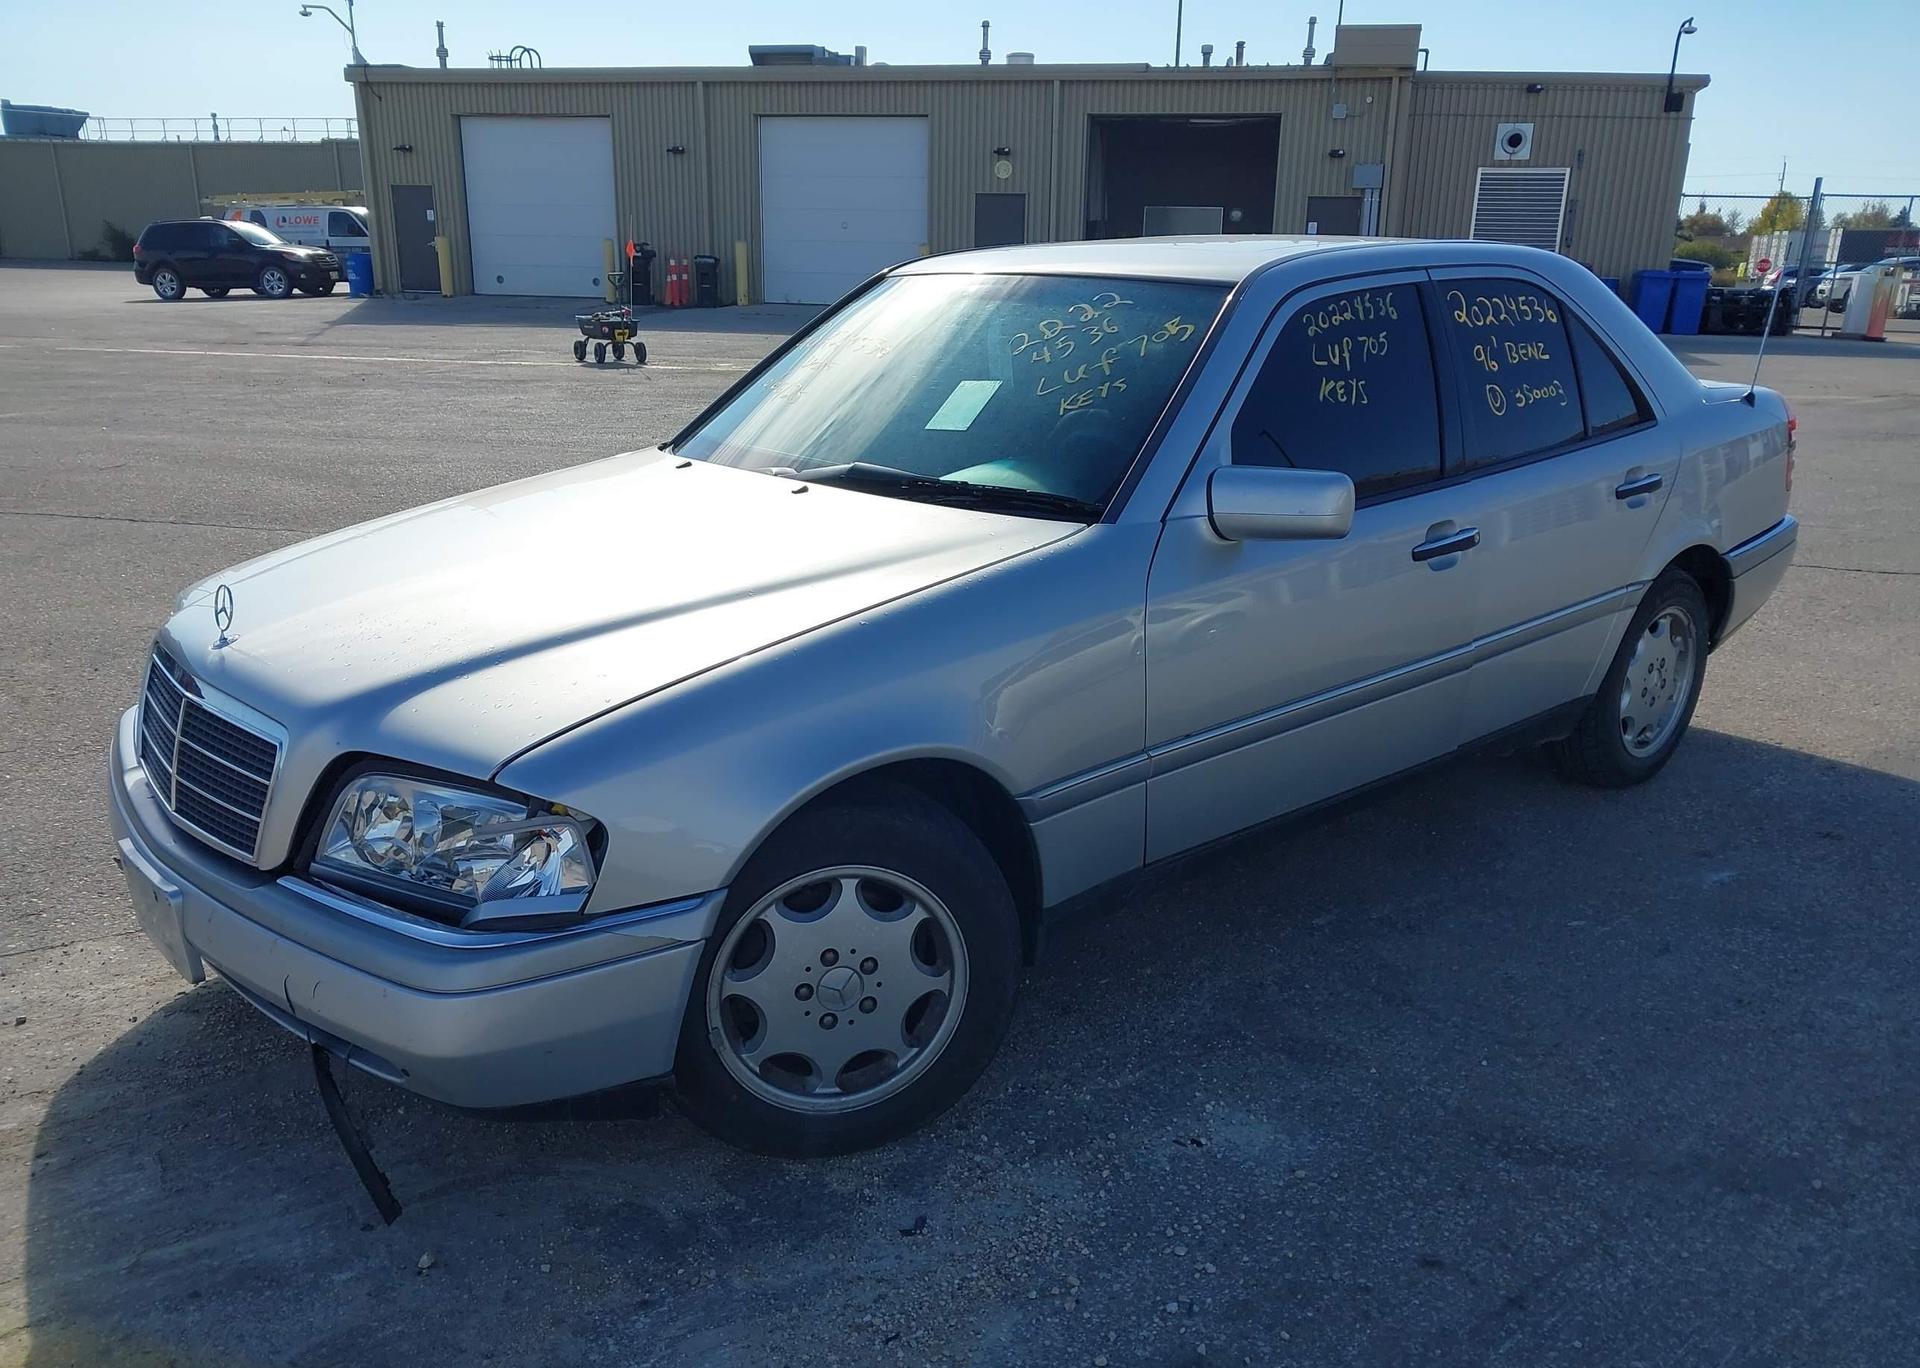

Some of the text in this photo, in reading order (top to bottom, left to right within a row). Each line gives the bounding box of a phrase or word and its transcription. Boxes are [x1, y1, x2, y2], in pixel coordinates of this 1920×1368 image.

[288, 215, 320, 225] LOWE
[1303, 292, 1399, 337] 20224536
[1447, 290, 1558, 328] 20224536
[1030, 316, 1119, 363] 4536
[1127, 315, 1195, 357] 705
[1357, 331, 1389, 363] 705
[1504, 341, 1550, 364] BENZ
[1319, 376, 1368, 405] KEYS
